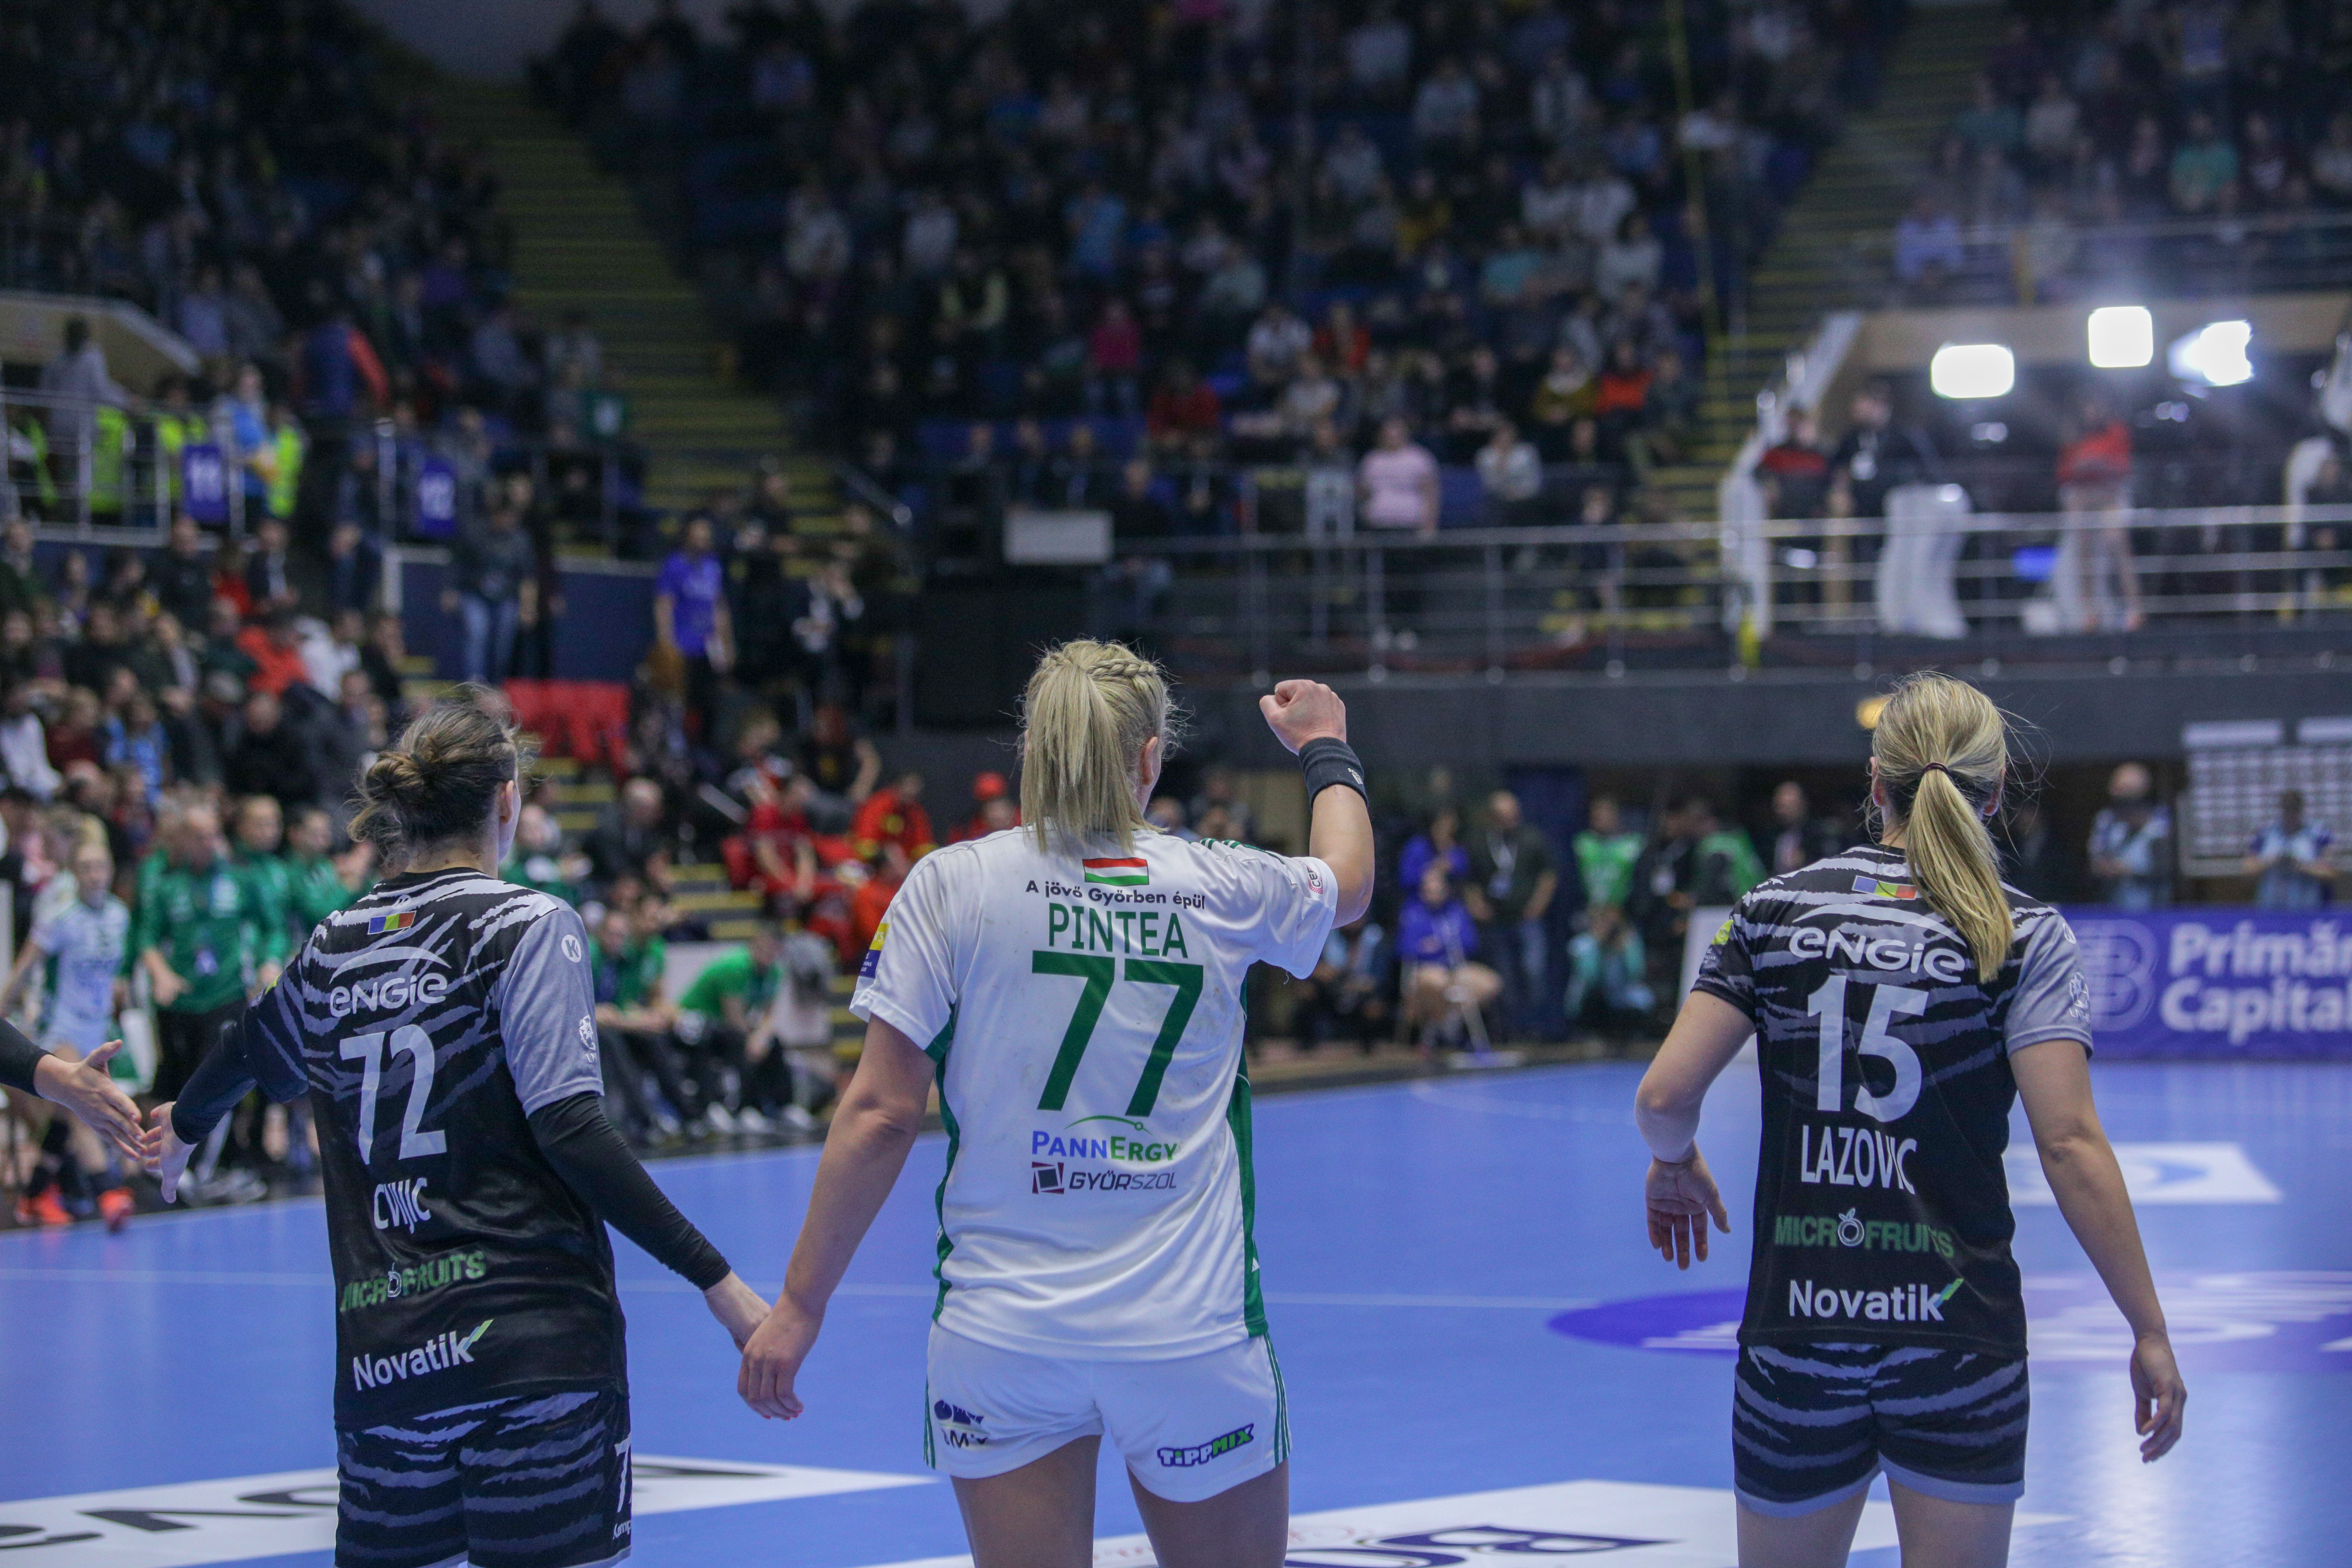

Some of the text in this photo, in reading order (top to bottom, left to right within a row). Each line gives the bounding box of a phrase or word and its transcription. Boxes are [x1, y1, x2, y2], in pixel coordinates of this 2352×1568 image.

[1026, 880, 1039, 893] A
[1088, 888, 1167, 906] Győrben
[1172, 891, 1205, 910] épül
[1048, 902, 1189, 959] PINTEA
[1032, 950, 1204, 1117] 77
[1807, 974, 1929, 1123] 15
[339, 1024, 447, 1165] 72
[1801, 1124, 1917, 1195] LAZOVIC
[1788, 1278, 1960, 1321] Novatik
[352, 1321, 491, 1391] Novatik
